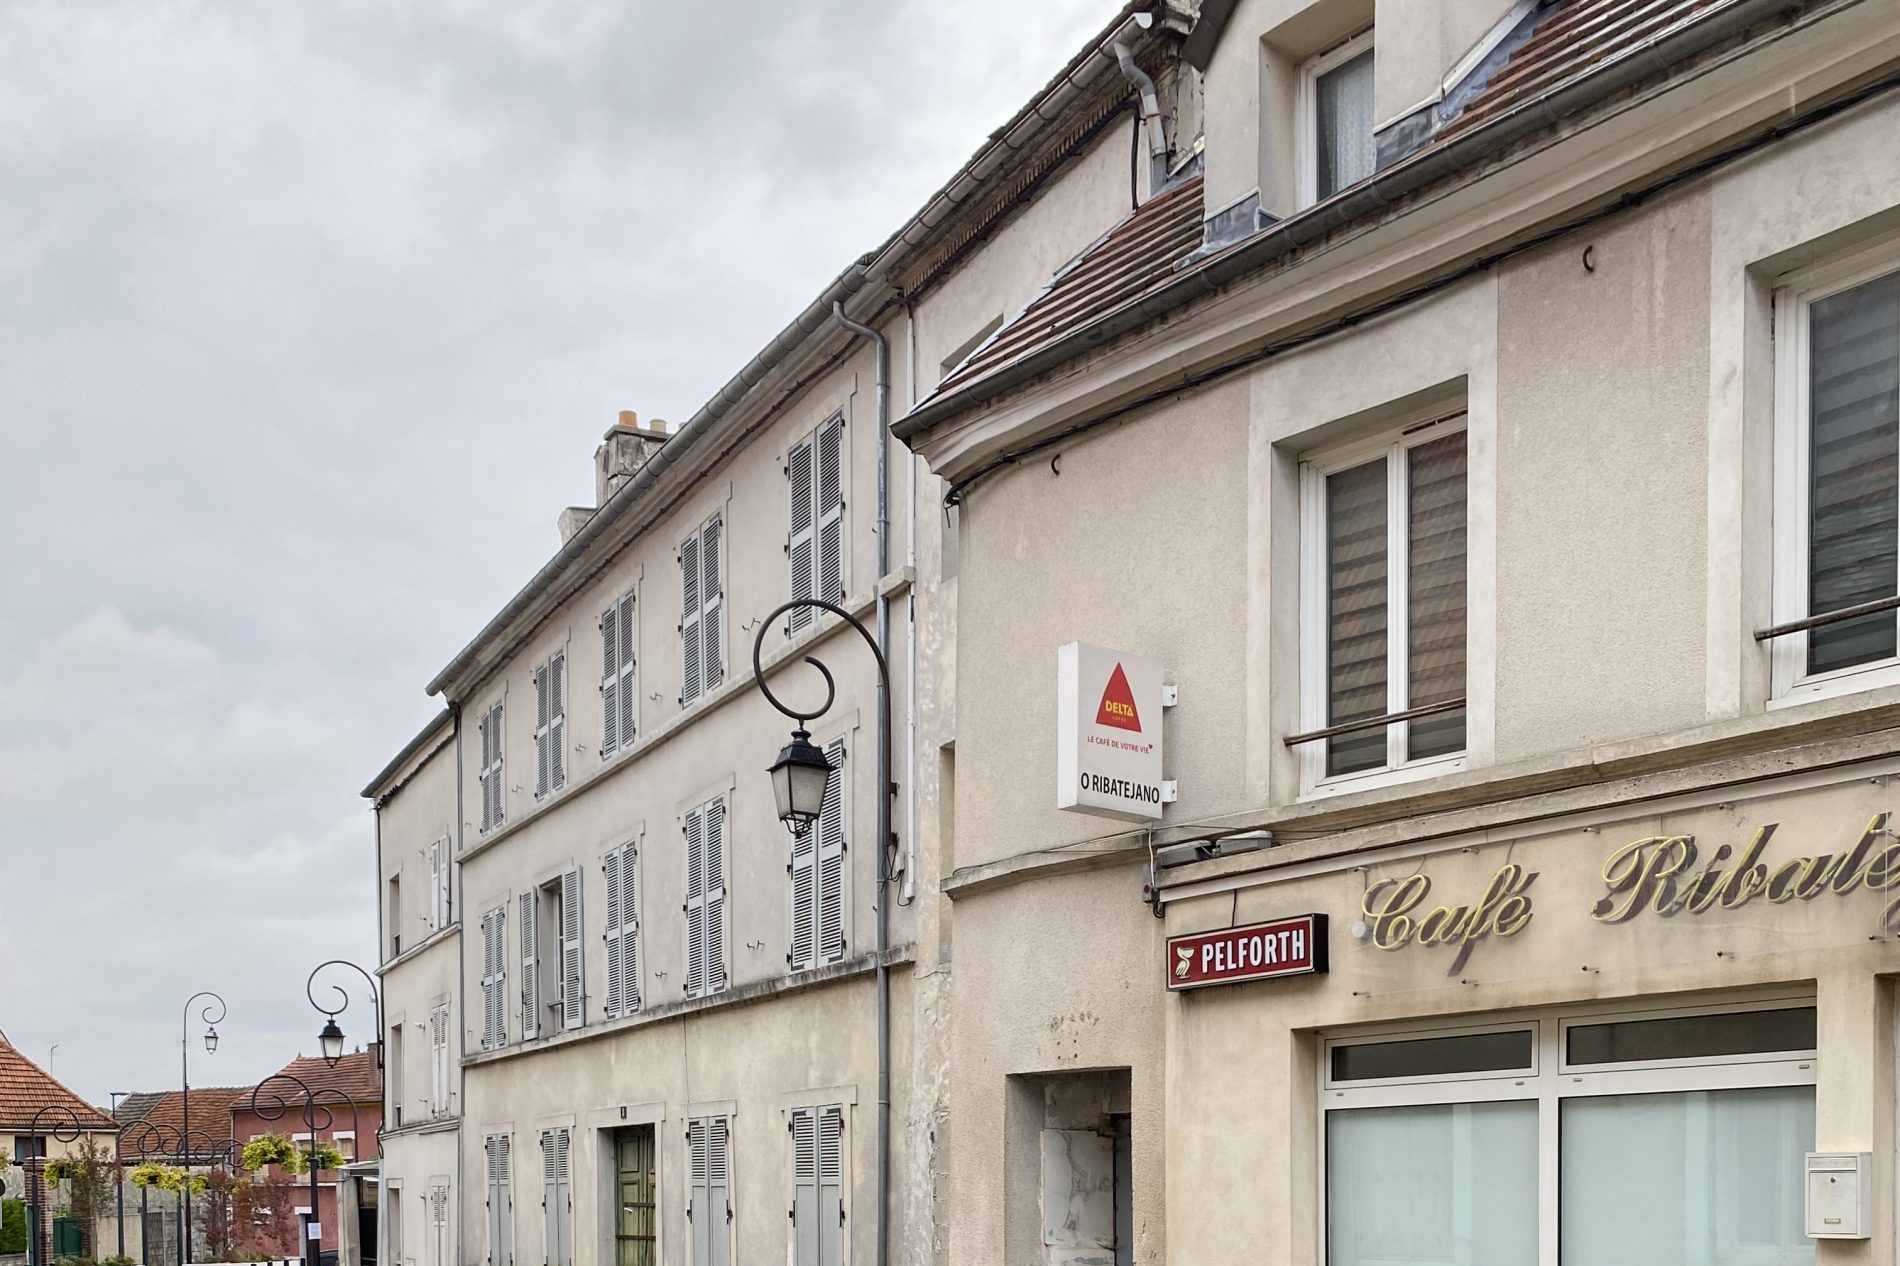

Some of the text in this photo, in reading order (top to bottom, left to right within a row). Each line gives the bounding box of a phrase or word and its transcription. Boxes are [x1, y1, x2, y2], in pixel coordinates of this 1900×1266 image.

[1105, 700, 1134, 717] DELTA
[1087, 735, 1095, 743] LE
[1111, 740, 1119, 748] DE
[1120, 742, 1139, 752] VOTRE
[1140, 746, 1149, 754] VIE
[1080, 772, 1160, 804] O RIBATEJANO
[1361, 811, 1900, 977] Café Ribate
[1202, 928, 1305, 974] PELFORTH
